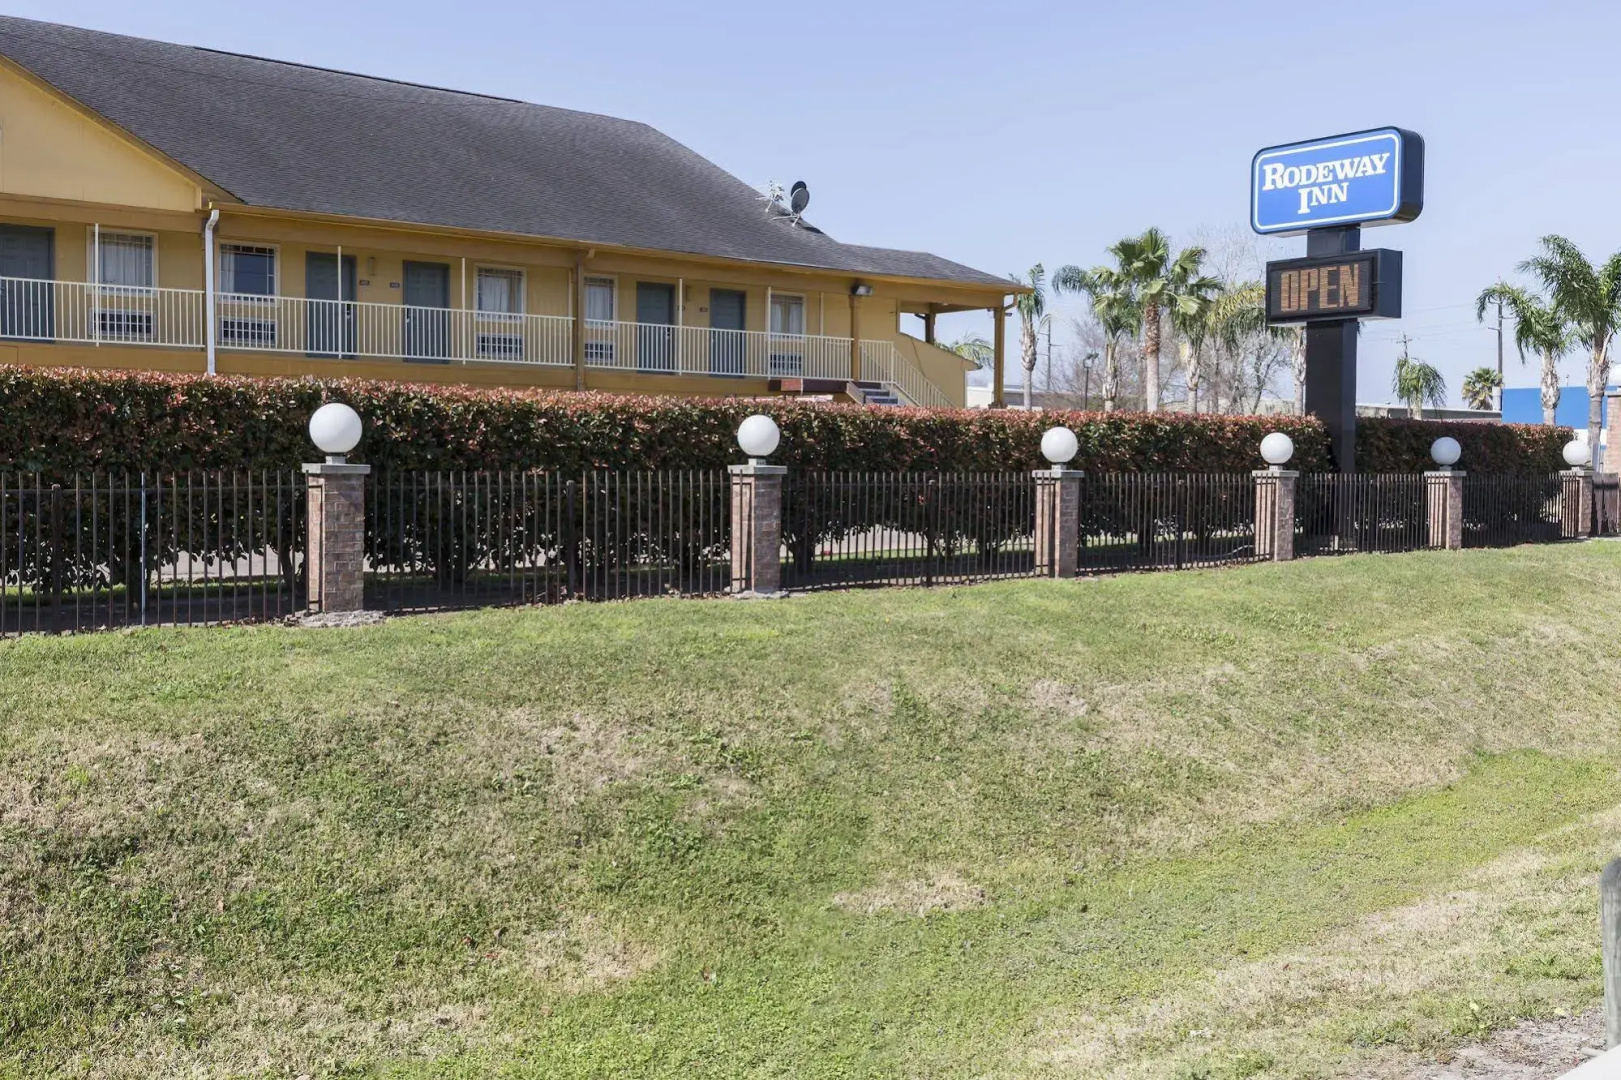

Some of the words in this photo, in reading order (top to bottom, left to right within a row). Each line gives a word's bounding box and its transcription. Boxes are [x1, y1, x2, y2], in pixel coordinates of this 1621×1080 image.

[1262, 153, 1390, 191] RODEWAY
[1298, 182, 1349, 214] INN
[1280, 264, 1359, 312] OPEN
